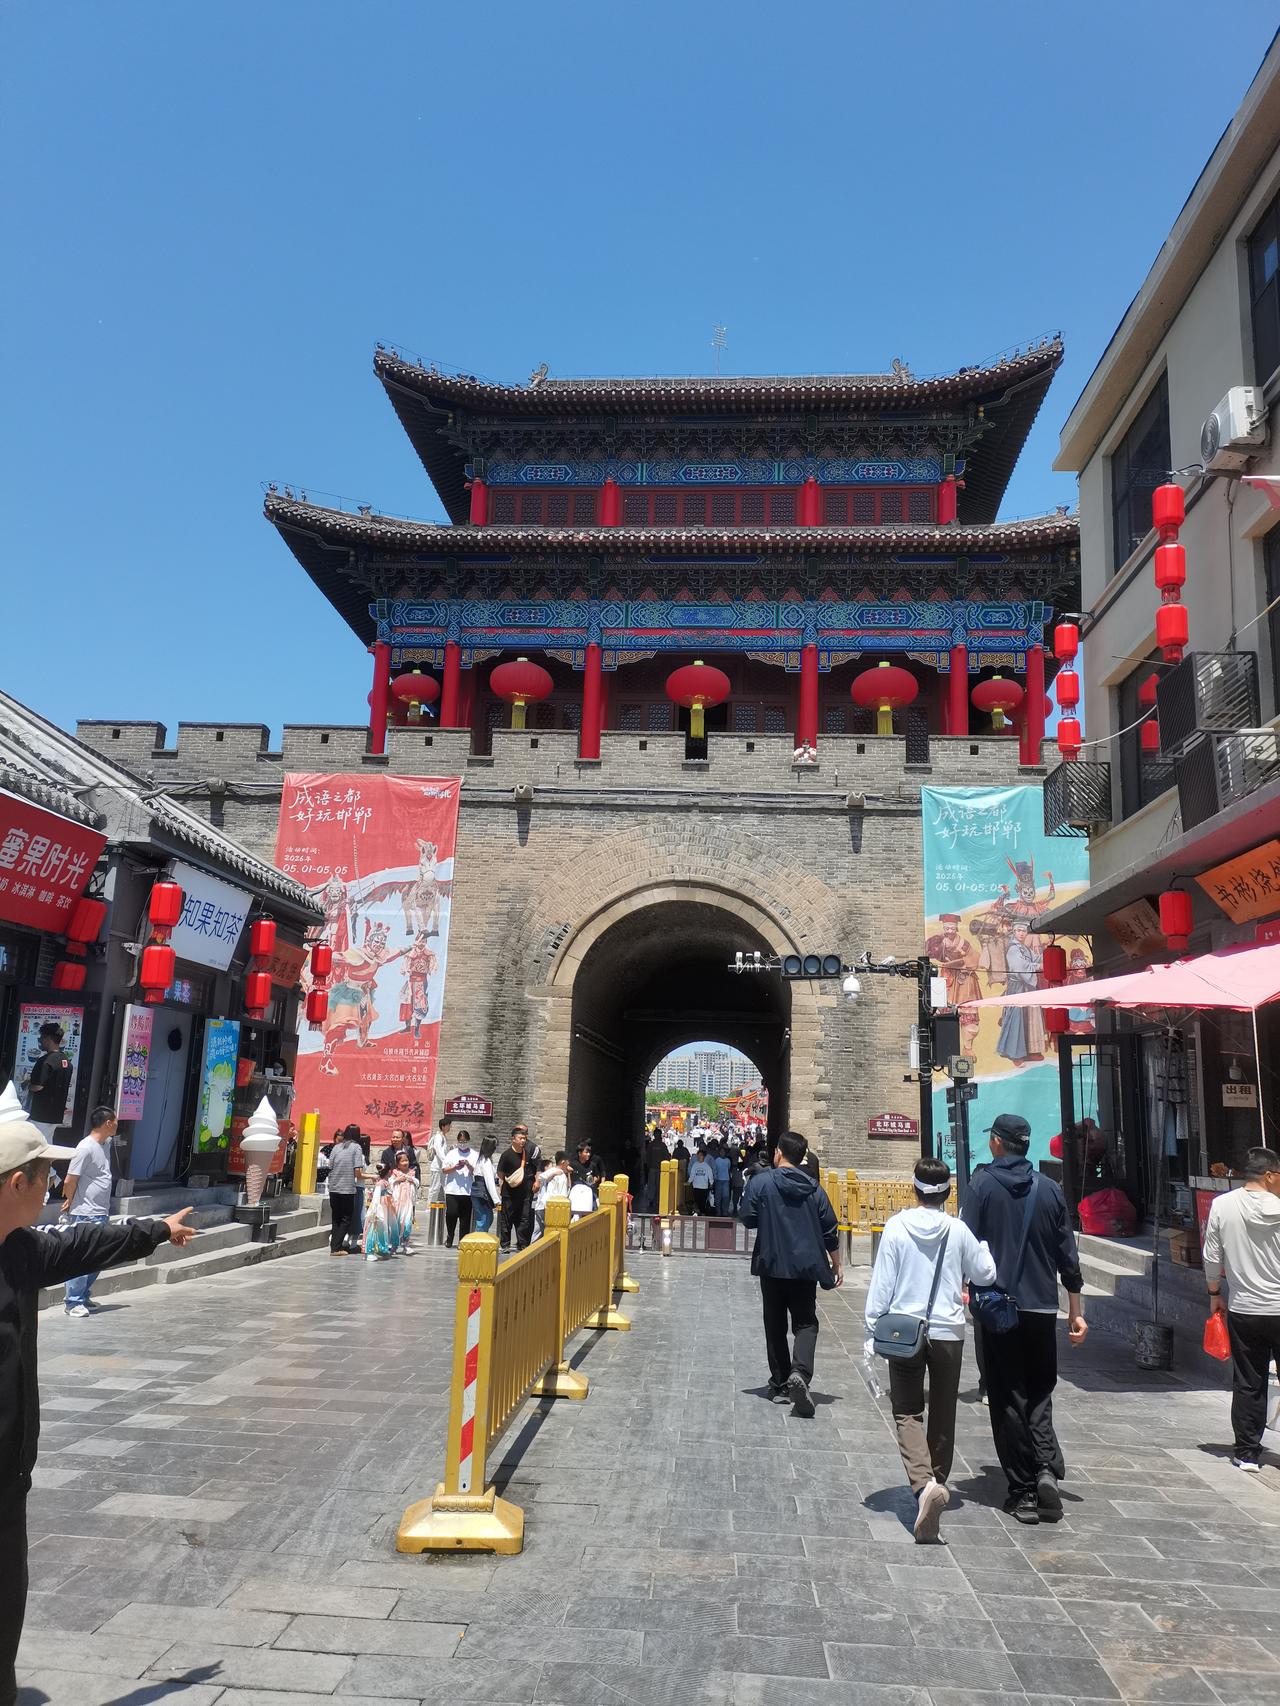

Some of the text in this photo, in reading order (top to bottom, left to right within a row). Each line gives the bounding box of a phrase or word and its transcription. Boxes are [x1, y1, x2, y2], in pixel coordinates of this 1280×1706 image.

[288, 785, 361, 809] 成语之都
[289, 806, 372, 834] 好玩邯郸
[932, 800, 1007, 825] 成语之都
[934, 820, 1021, 850] 好玩邯郸
[0, 828, 90, 890] 蜜果时光
[178, 894, 243, 945] 知果知茶
[1226, 1085, 1252, 1094] 出租
